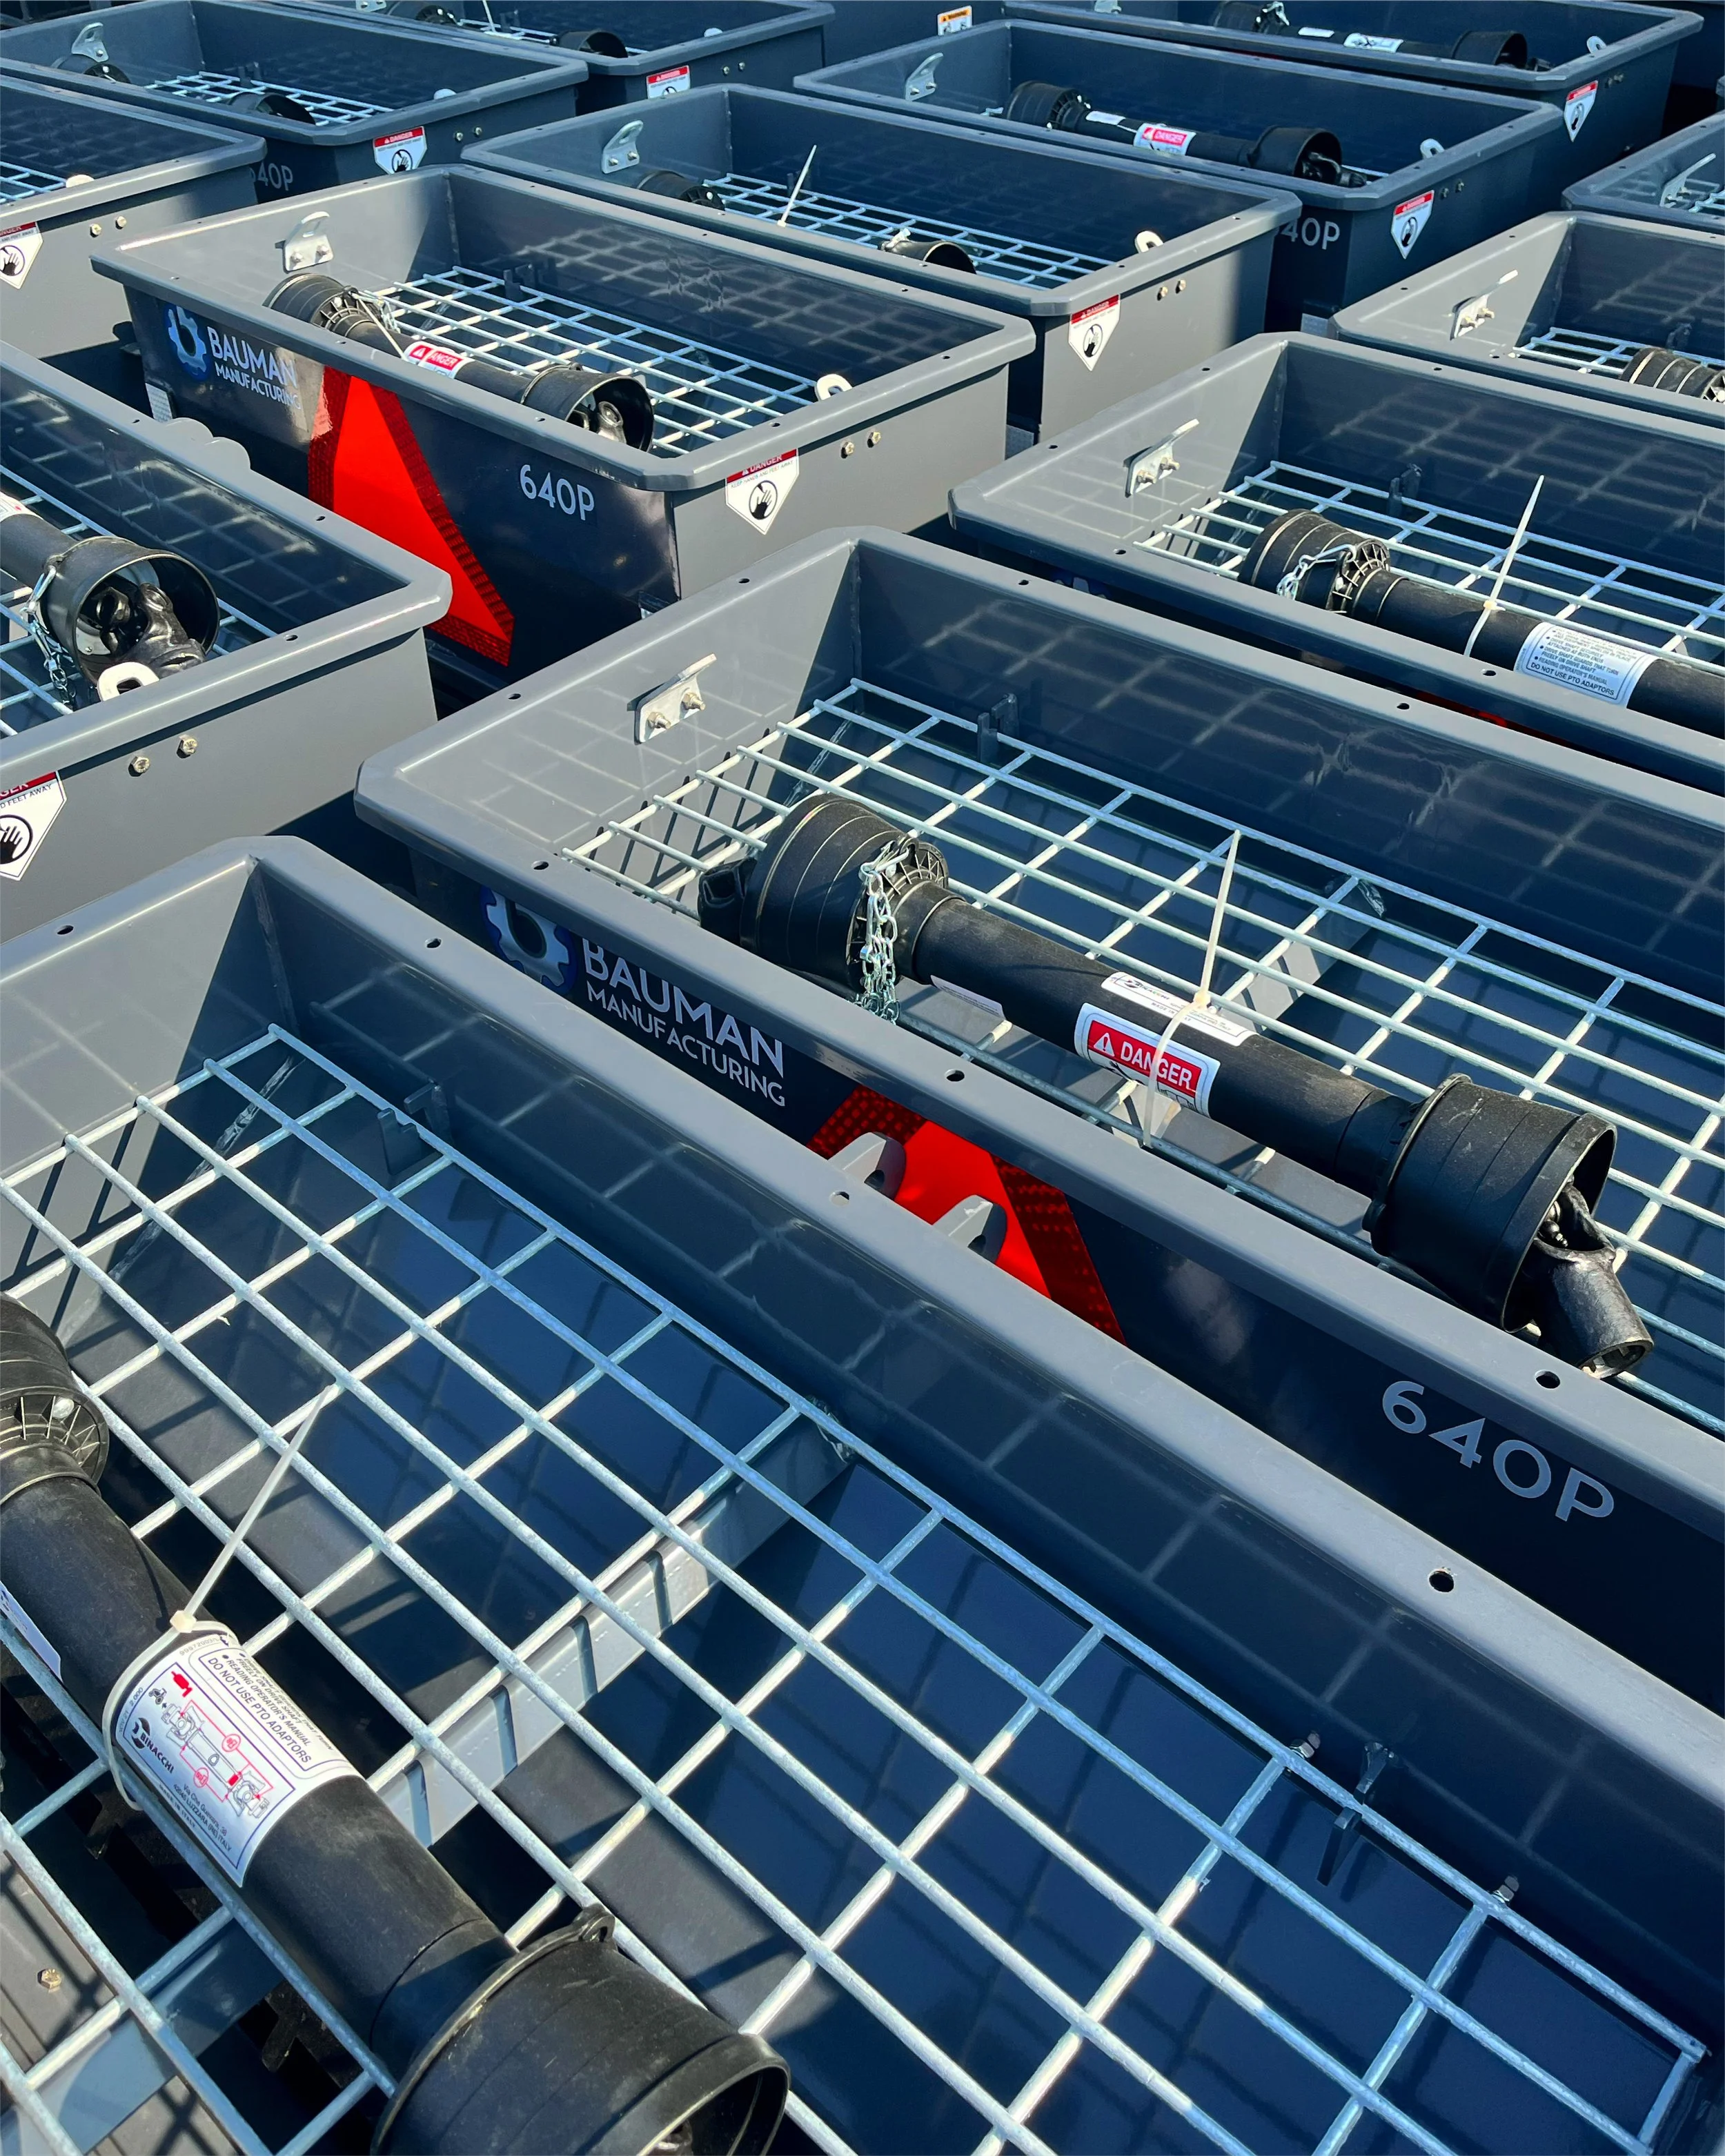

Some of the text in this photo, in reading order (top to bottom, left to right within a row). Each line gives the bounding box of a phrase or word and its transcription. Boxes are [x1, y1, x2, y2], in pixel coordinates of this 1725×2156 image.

[1277, 217, 1341, 250] 40P
[207, 326, 298, 389] BAUMAN
[215, 362, 302, 410] MANUFACTURING
[520, 464, 595, 522] 640P
[1530, 661, 1615, 695] DO NOT USE PTO ADAPTORS
[8, 793, 27, 807] FEET
[29, 783, 52, 798] AWAY
[582, 938, 784, 1078] BAUMAN
[586, 980, 785, 1107] MANUFACTURING
[1120, 1041, 1193, 1090] DANGER
[1382, 1381, 1615, 1522] 640P
[208, 1657, 312, 1763] DO NOT USE PTO ADAPTORS
[226, 1659, 312, 1746] READING OPERATOR'S MANUAL
[236, 1658, 304, 1724] FREELY ON DRIVE SHAFT
[140, 1732, 175, 1774] BINACCHI
[181, 1808, 196, 1828] ITALY
[186, 1799, 208, 1827] LUZZARA
[217, 1836, 233, 1852] ITALY
